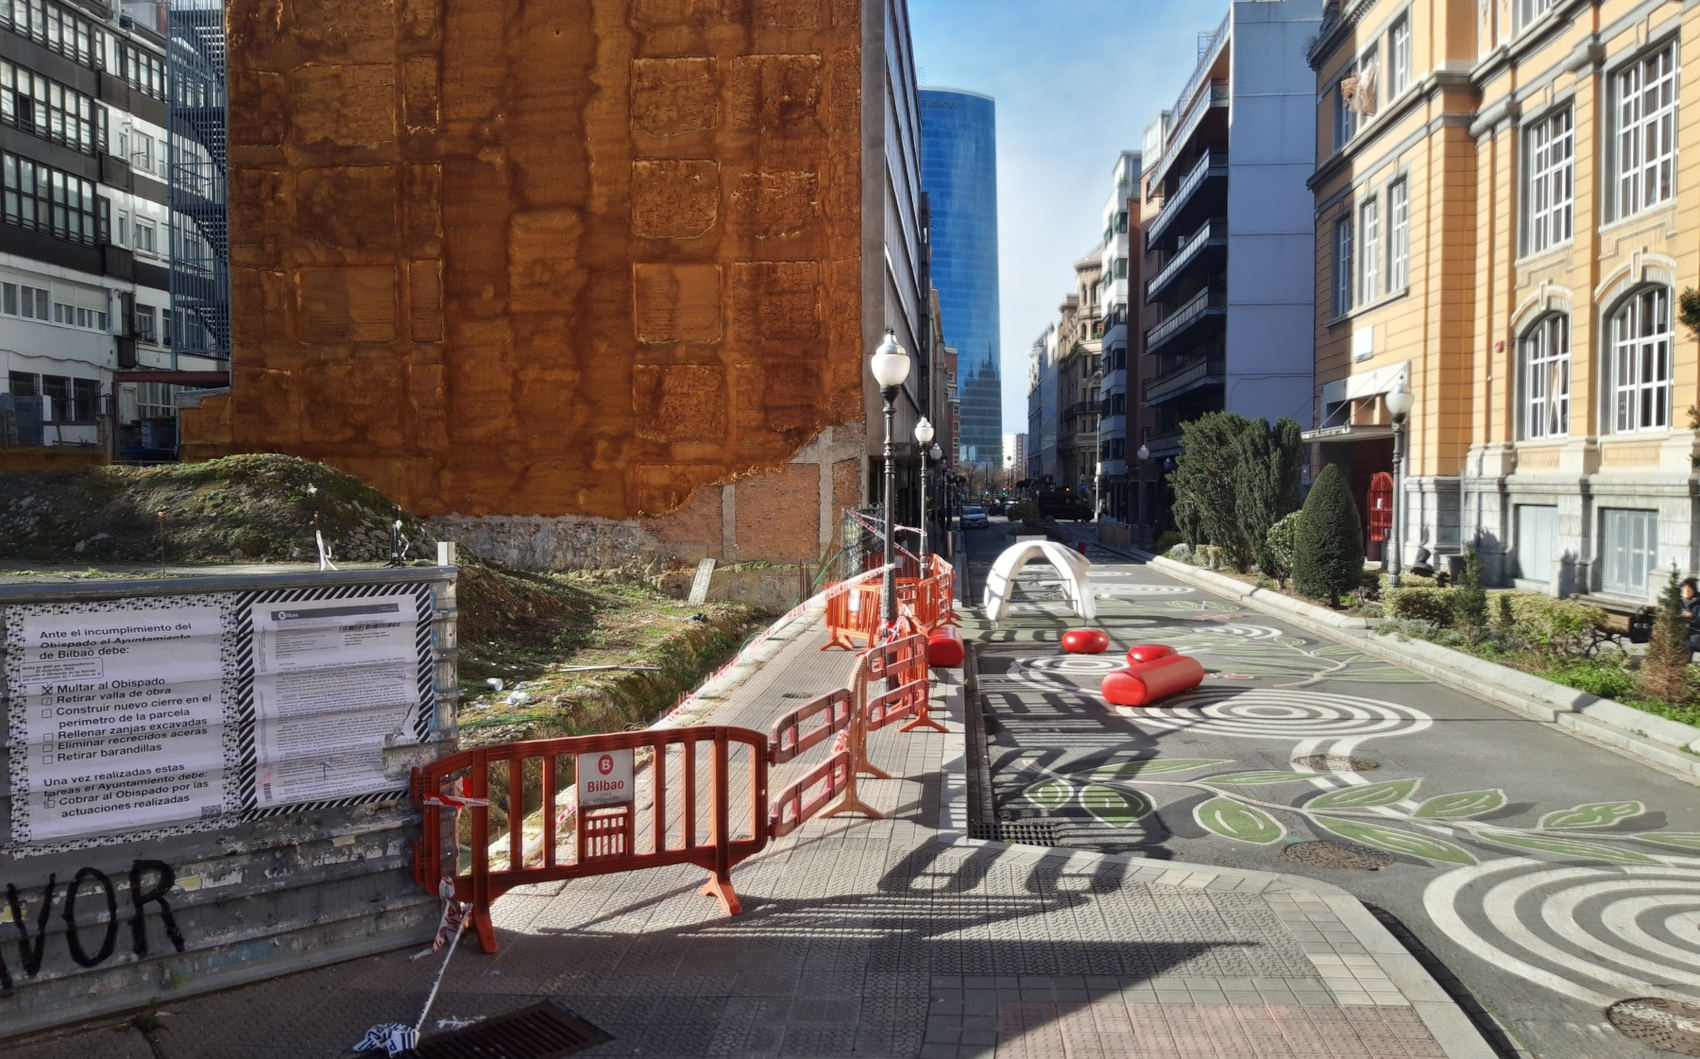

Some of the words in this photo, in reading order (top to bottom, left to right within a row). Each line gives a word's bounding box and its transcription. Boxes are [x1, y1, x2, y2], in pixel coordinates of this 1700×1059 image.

[40, 631, 68, 639] Ante
[71, 629, 81, 637] el
[85, 624, 172, 638] incumplimiento
[40, 639, 96, 649] Obispado
[114, 634, 191, 644] Ayuntamiento
[40, 652, 54, 660] de
[58, 648, 94, 659] Bilbao
[98, 646, 129, 656] debe:
[57, 684, 94, 694] Multar
[98, 681, 108, 690] al
[112, 677, 165, 689] Obispado
[57, 694, 96, 704] Retirar
[100, 692, 126, 700] valla
[146, 687, 171, 695] obra
[56, 704, 111, 716] Construir
[114, 702, 148, 711] nuevo
[151, 698, 183, 707] cierre
[186, 696, 199, 704] en
[202, 694, 212, 702] el
[119, 714, 133, 722] de
[136, 713, 146, 721] la
[150, 708, 190, 720] parcela
[58, 728, 106, 740] Rellenar
[110, 724, 146, 736] zanjas
[149, 718, 208, 730] excavadas
[58, 738, 104, 750] Eliminar
[108, 733, 167, 744] recrecidos
[170, 728, 207, 738] aceras
[57, 751, 97, 762] Retirar
[101, 744, 162, 757] barandillas
[44, 778, 68, 787] Una
[94, 768, 152, 781] realizadas
[155, 763, 185, 773] estas
[44, 784, 81, 798] tareas
[84, 784, 95, 792] el
[98, 776, 175, 790] Ayuntamiento
[178, 771, 208, 781] debe:
[59, 795, 98, 806] Cobrar
[103, 792, 112, 800] al
[116, 786, 168, 798] Obispado
[172, 783, 190, 792] por
[194, 780, 208, 788] las
[587, 780, 624, 792] Bilbao
[62, 803, 131, 818] actuaciones
[134, 795, 190, 808] realizadas
[0, 859, 186, 990] VOR
